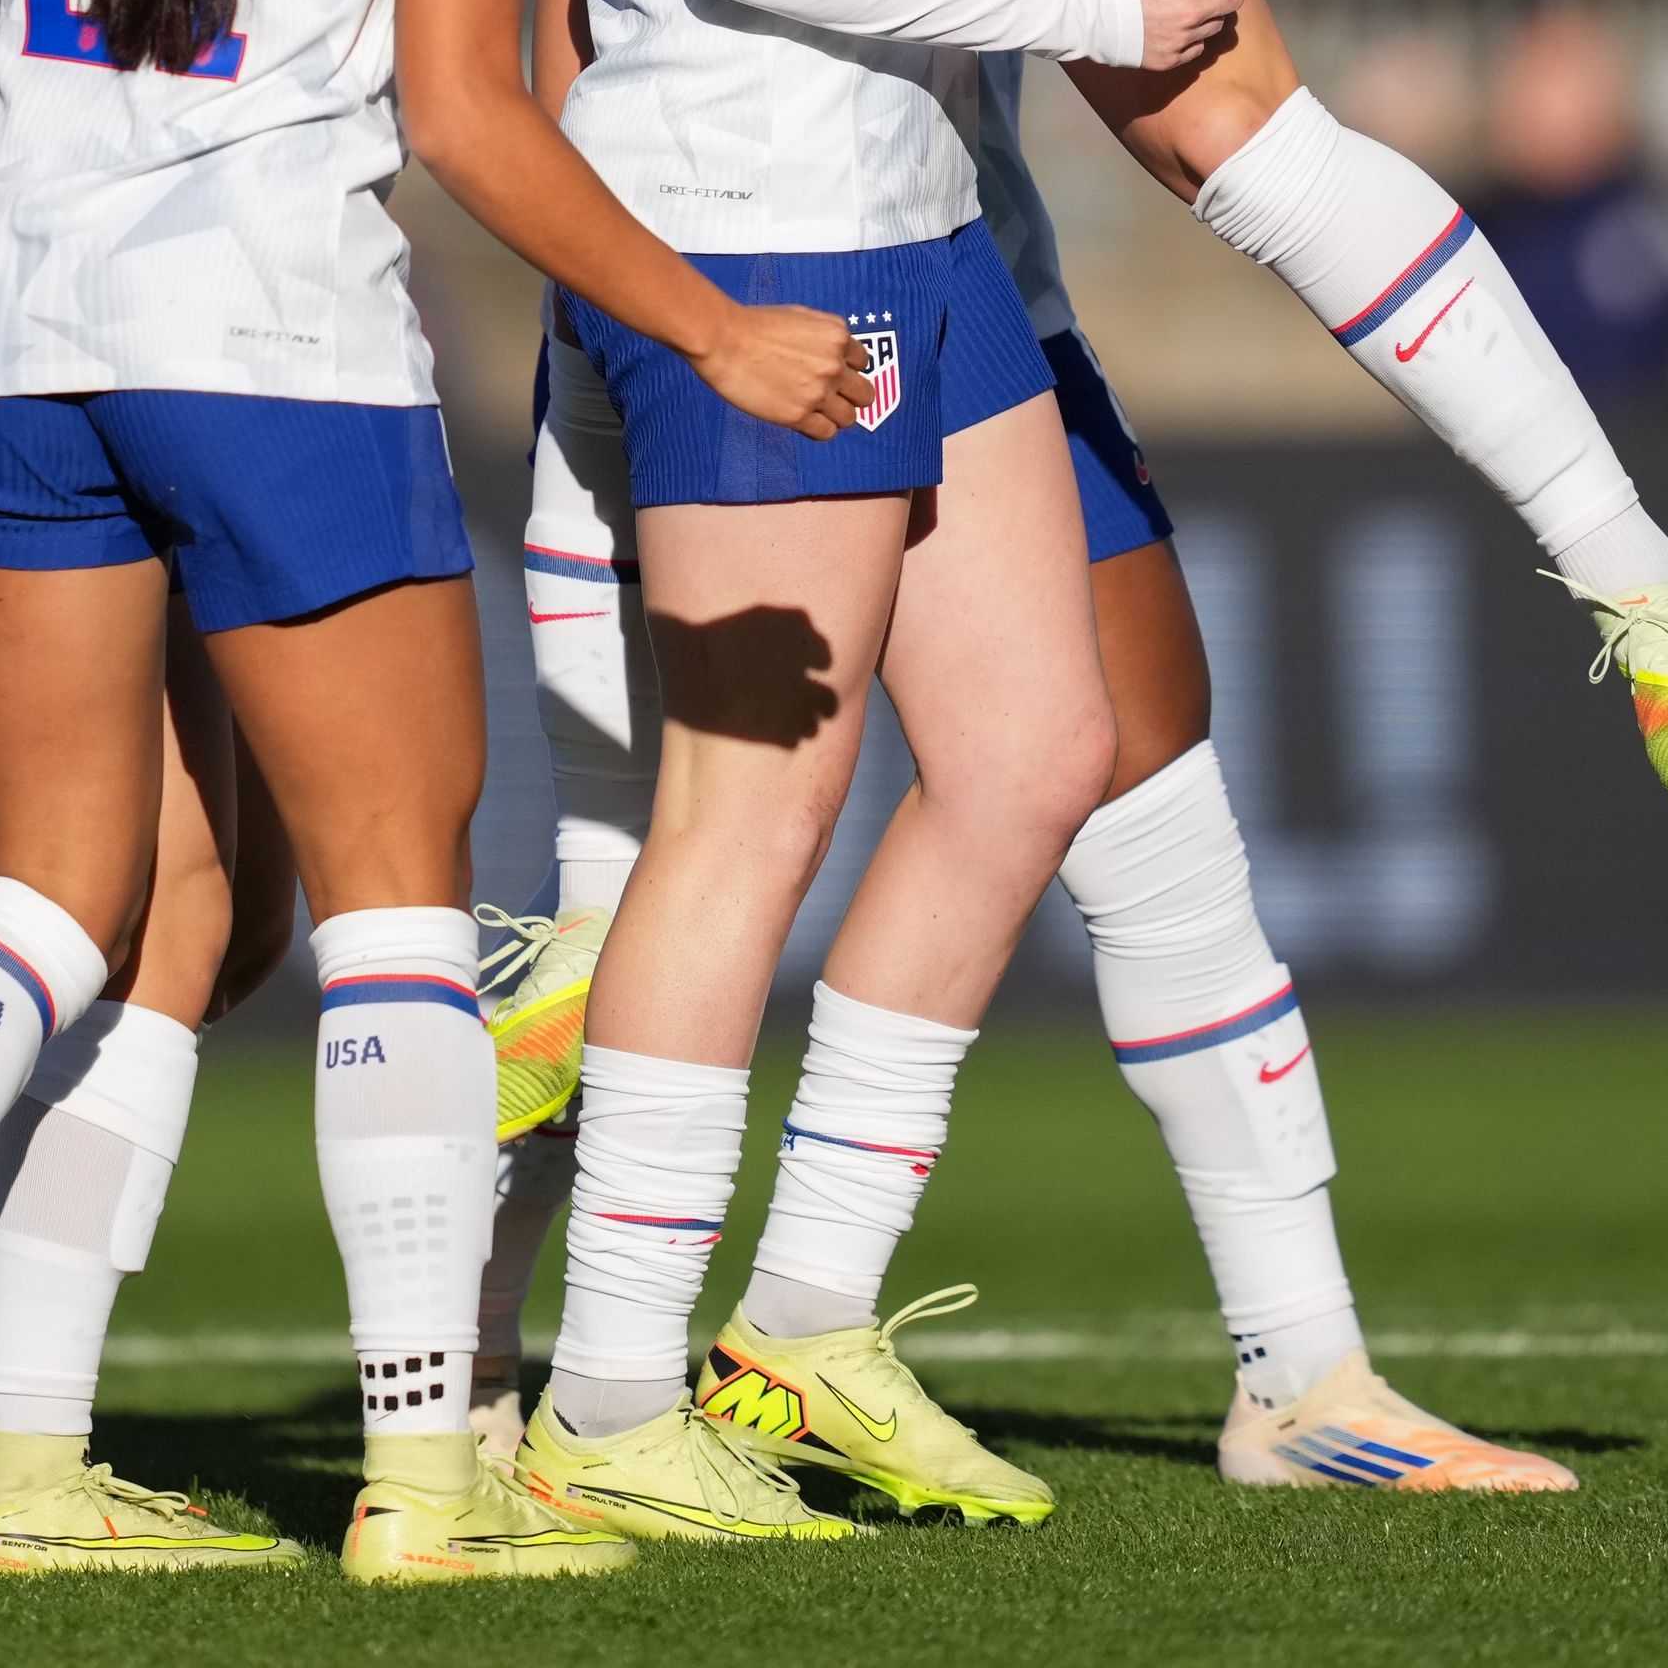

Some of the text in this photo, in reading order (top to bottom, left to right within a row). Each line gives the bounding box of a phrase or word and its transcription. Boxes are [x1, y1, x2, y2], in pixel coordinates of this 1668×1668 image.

[858, 337, 893, 374] SA
[326, 1036, 386, 1069] USA
[581, 1493, 627, 1510] MOULTRIE
